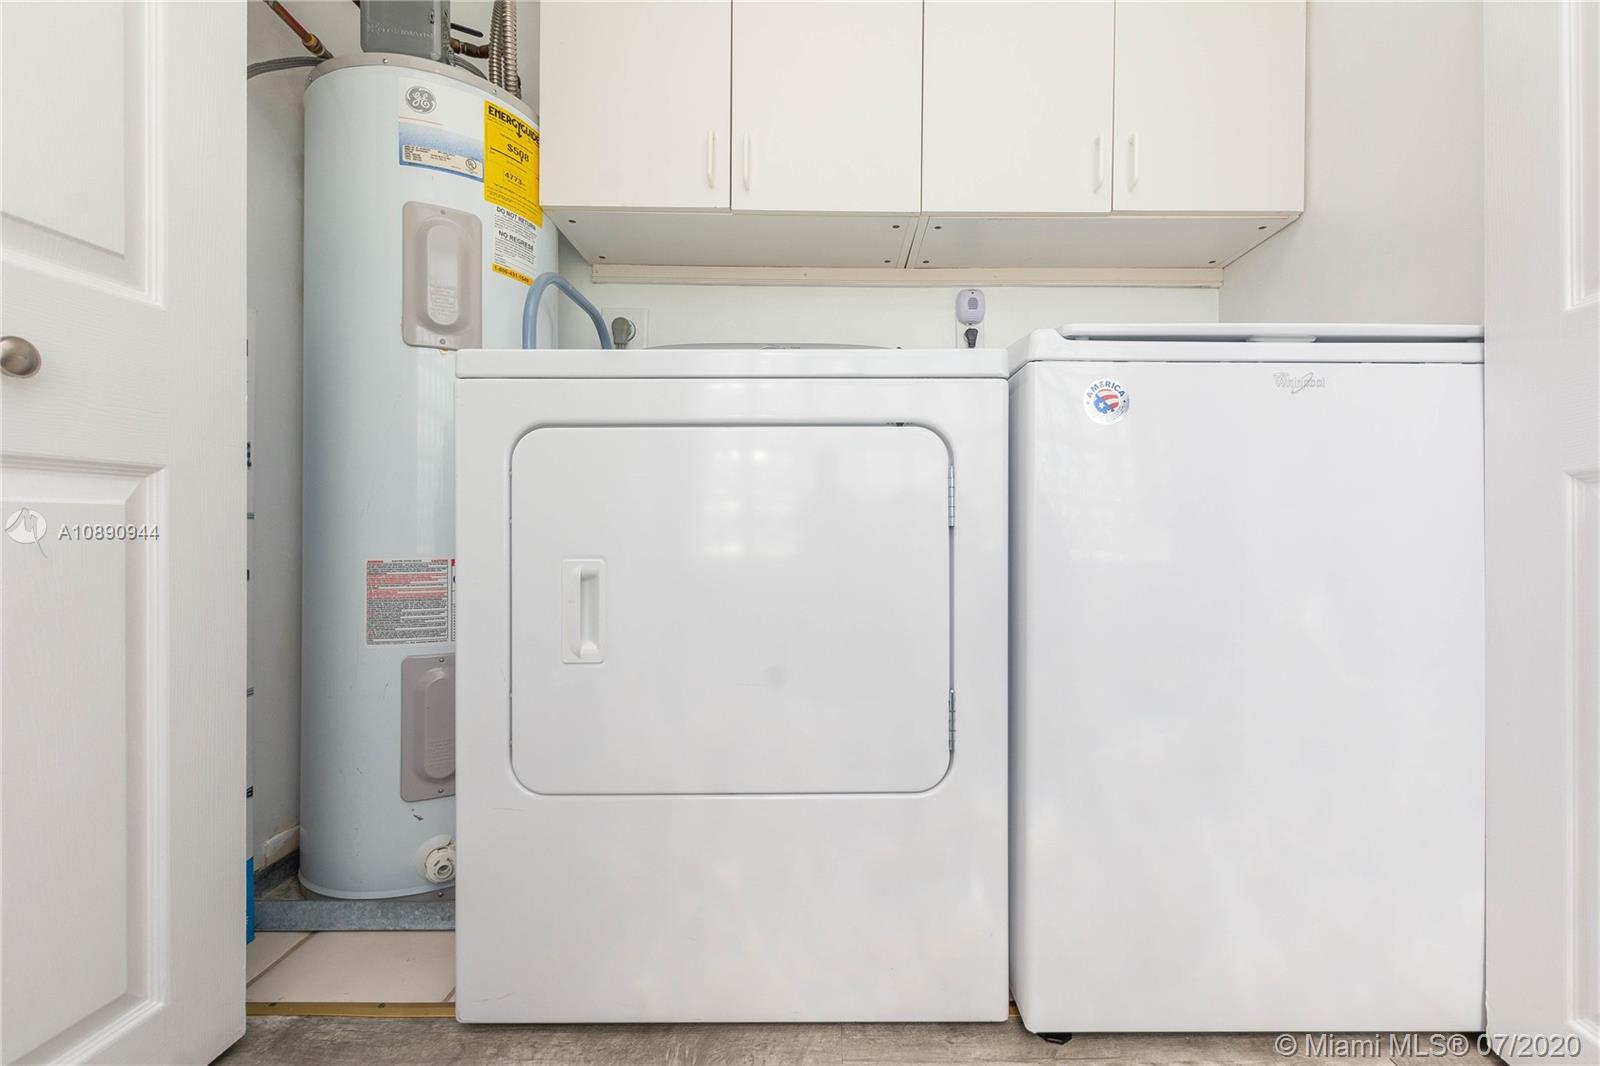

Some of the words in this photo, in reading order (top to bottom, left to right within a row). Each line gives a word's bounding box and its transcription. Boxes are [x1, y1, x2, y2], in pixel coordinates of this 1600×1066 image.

[496, 206, 506, 215] DO
[506, 210, 518, 220] NOT
[498, 230, 509, 239] NO
[1086, 380, 1126, 398] AMERICA
